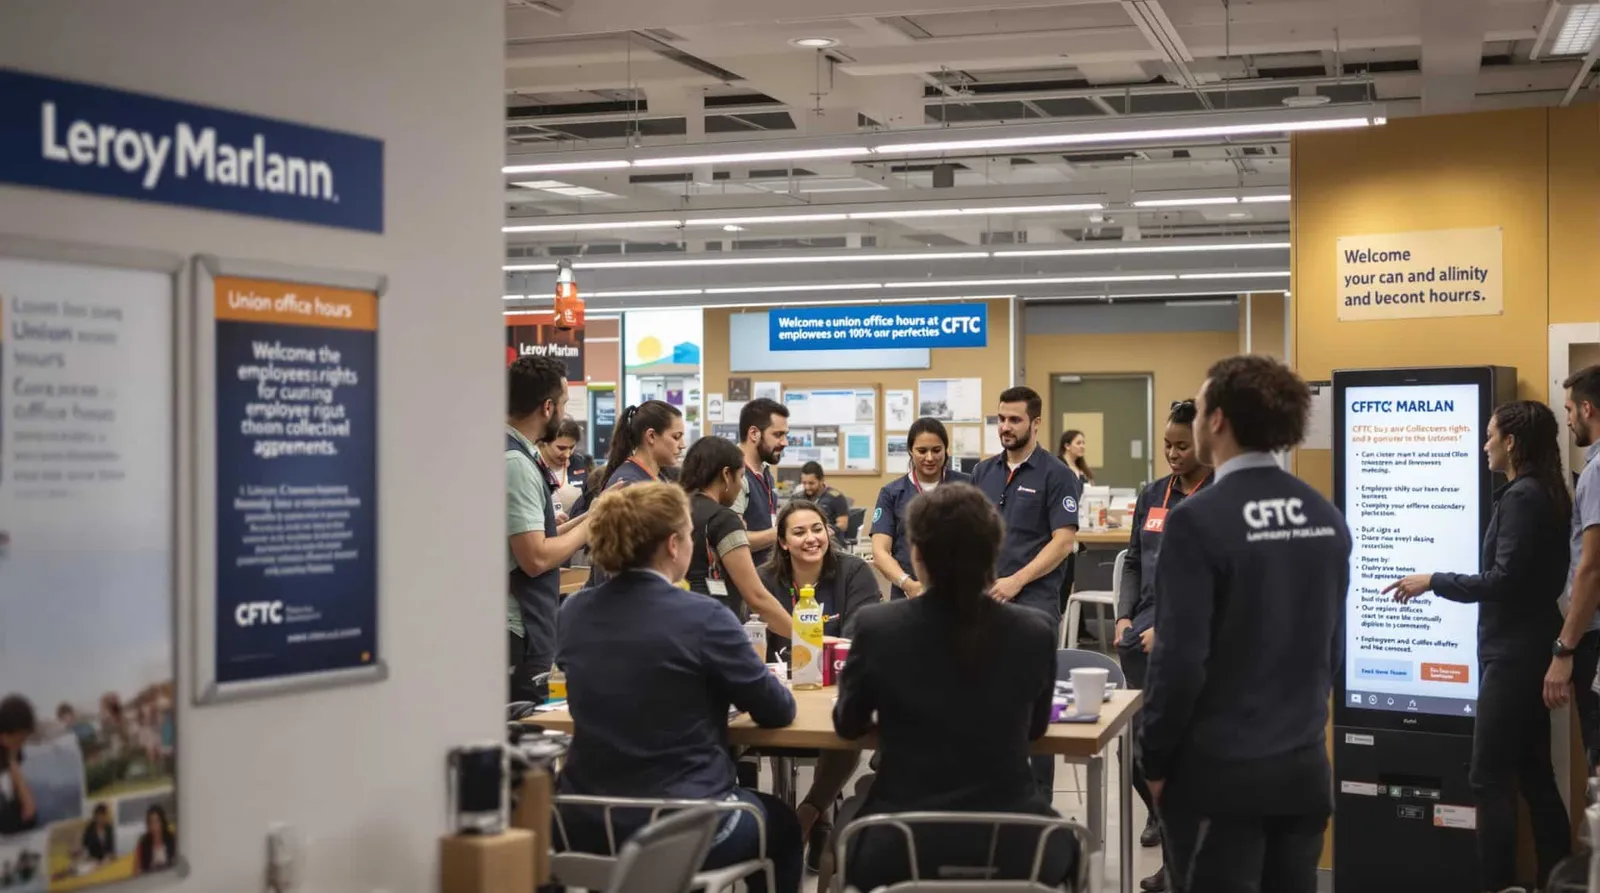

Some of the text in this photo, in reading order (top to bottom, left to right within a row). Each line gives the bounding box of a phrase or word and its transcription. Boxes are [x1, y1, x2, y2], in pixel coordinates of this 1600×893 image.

[42, 101, 170, 189] Leroy
[1344, 249, 1411, 263] Welcome
[1344, 274, 1375, 288] your
[1379, 272, 1403, 284] can
[1408, 267, 1435, 282] and
[228, 290, 352, 317] Union office hours
[1345, 291, 1370, 306] and
[778, 316, 823, 328] Welcome
[832, 316, 861, 327] union
[863, 315, 894, 326] office
[896, 314, 925, 326] hours
[927, 315, 938, 325] at
[941, 316, 981, 334] CFTC
[834, 331, 846, 339] on
[252, 340, 341, 363] Welcome the
[520, 342, 548, 357] Leroy
[1396, 400, 1454, 412] MARLAN
[1243, 497, 1308, 528] CFTC
[235, 600, 283, 626] CFTC
[800, 614, 819, 622] CFTC
